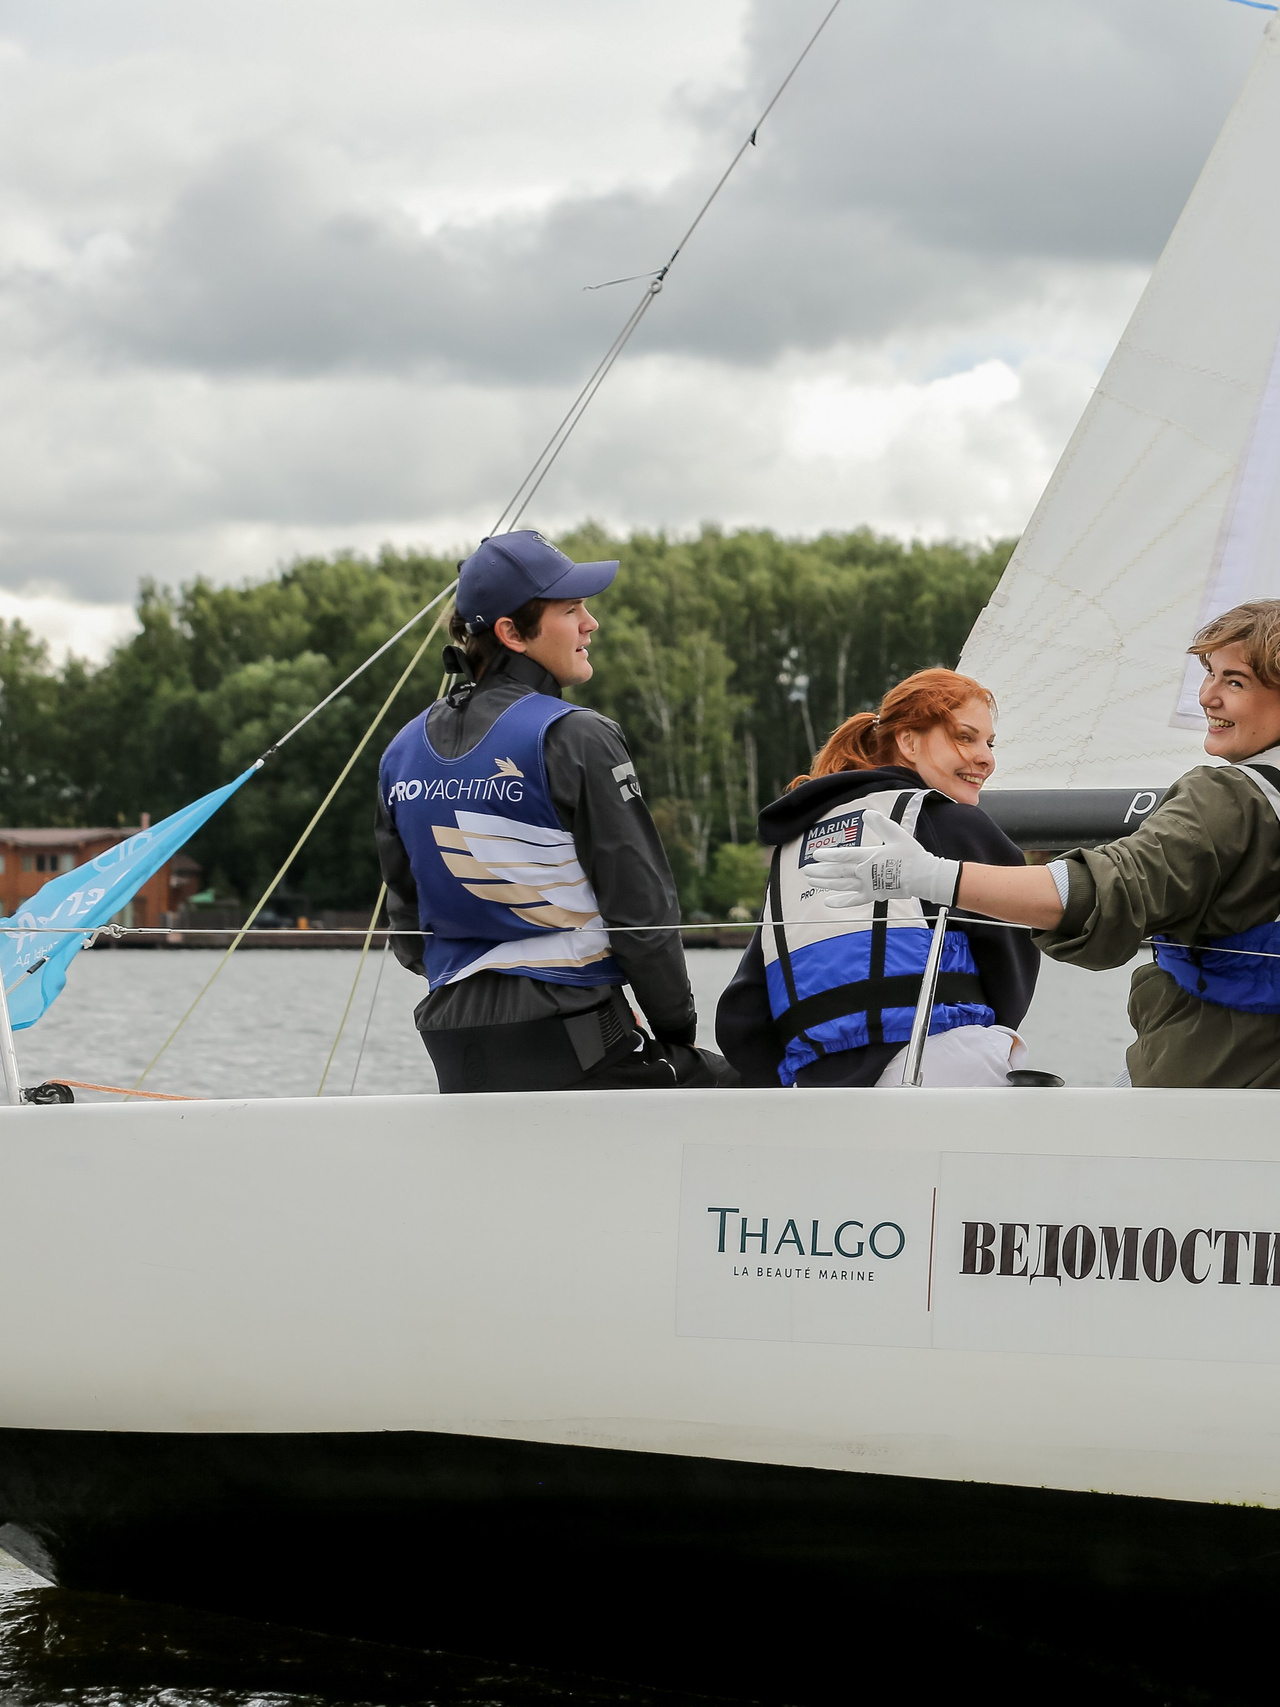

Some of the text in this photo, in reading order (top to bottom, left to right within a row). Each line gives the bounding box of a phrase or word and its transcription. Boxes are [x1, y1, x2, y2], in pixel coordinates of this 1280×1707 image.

[808, 817, 859, 840] MARINE
[808, 837, 836, 850] POOL
[733, 1265, 875, 1282] LA BEAUTÉ MARINE
